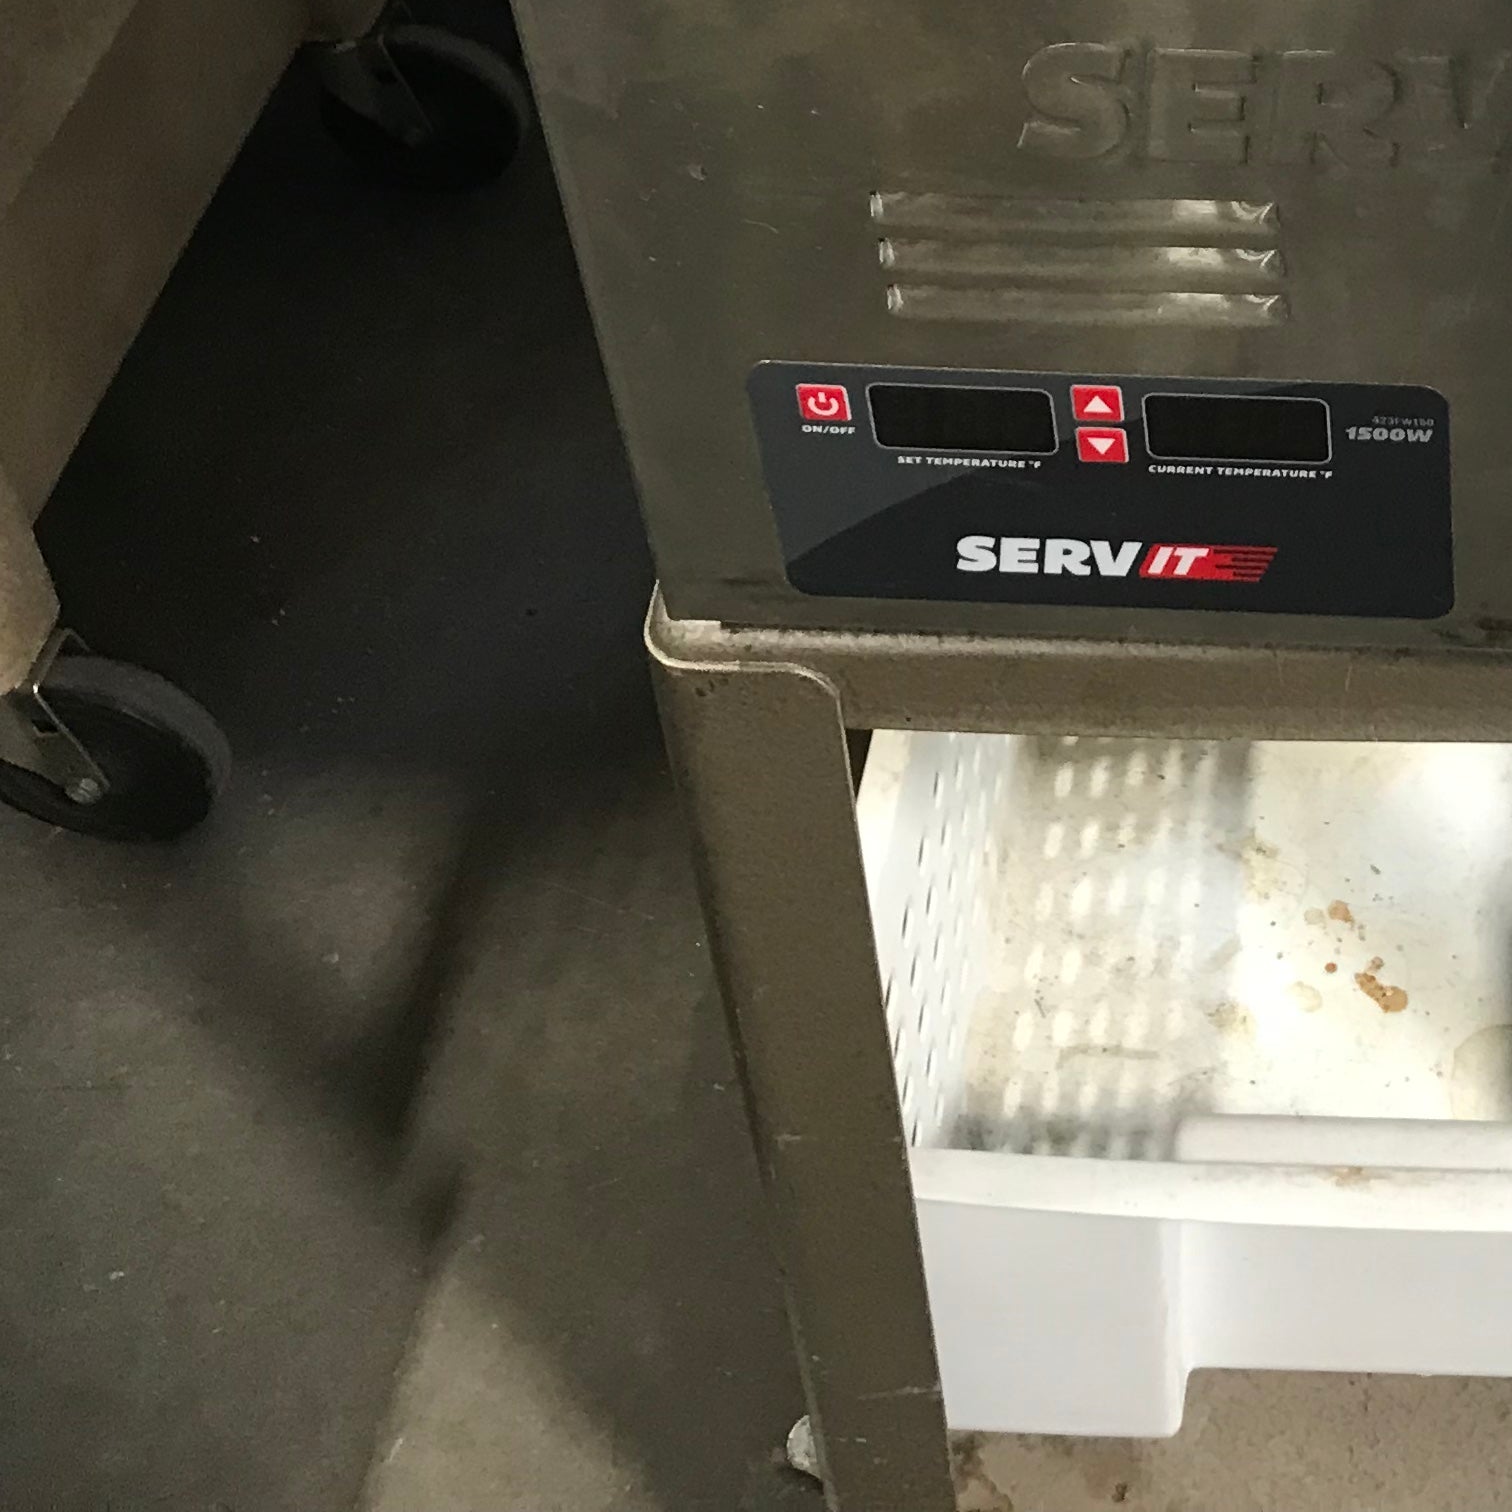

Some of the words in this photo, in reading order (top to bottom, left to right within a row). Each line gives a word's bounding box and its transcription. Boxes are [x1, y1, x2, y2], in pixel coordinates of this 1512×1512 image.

[801, 424, 856, 435] ON/OFF
[1345, 426, 1433, 442] 1500W
[897, 455, 922, 465] SET
[926, 456, 1026, 469] TEMPERATURE
[1148, 464, 1213, 475] CURRENT
[1216, 466, 1316, 478] TEMPERATURE
[956, 535, 1210, 577] SERVIT
